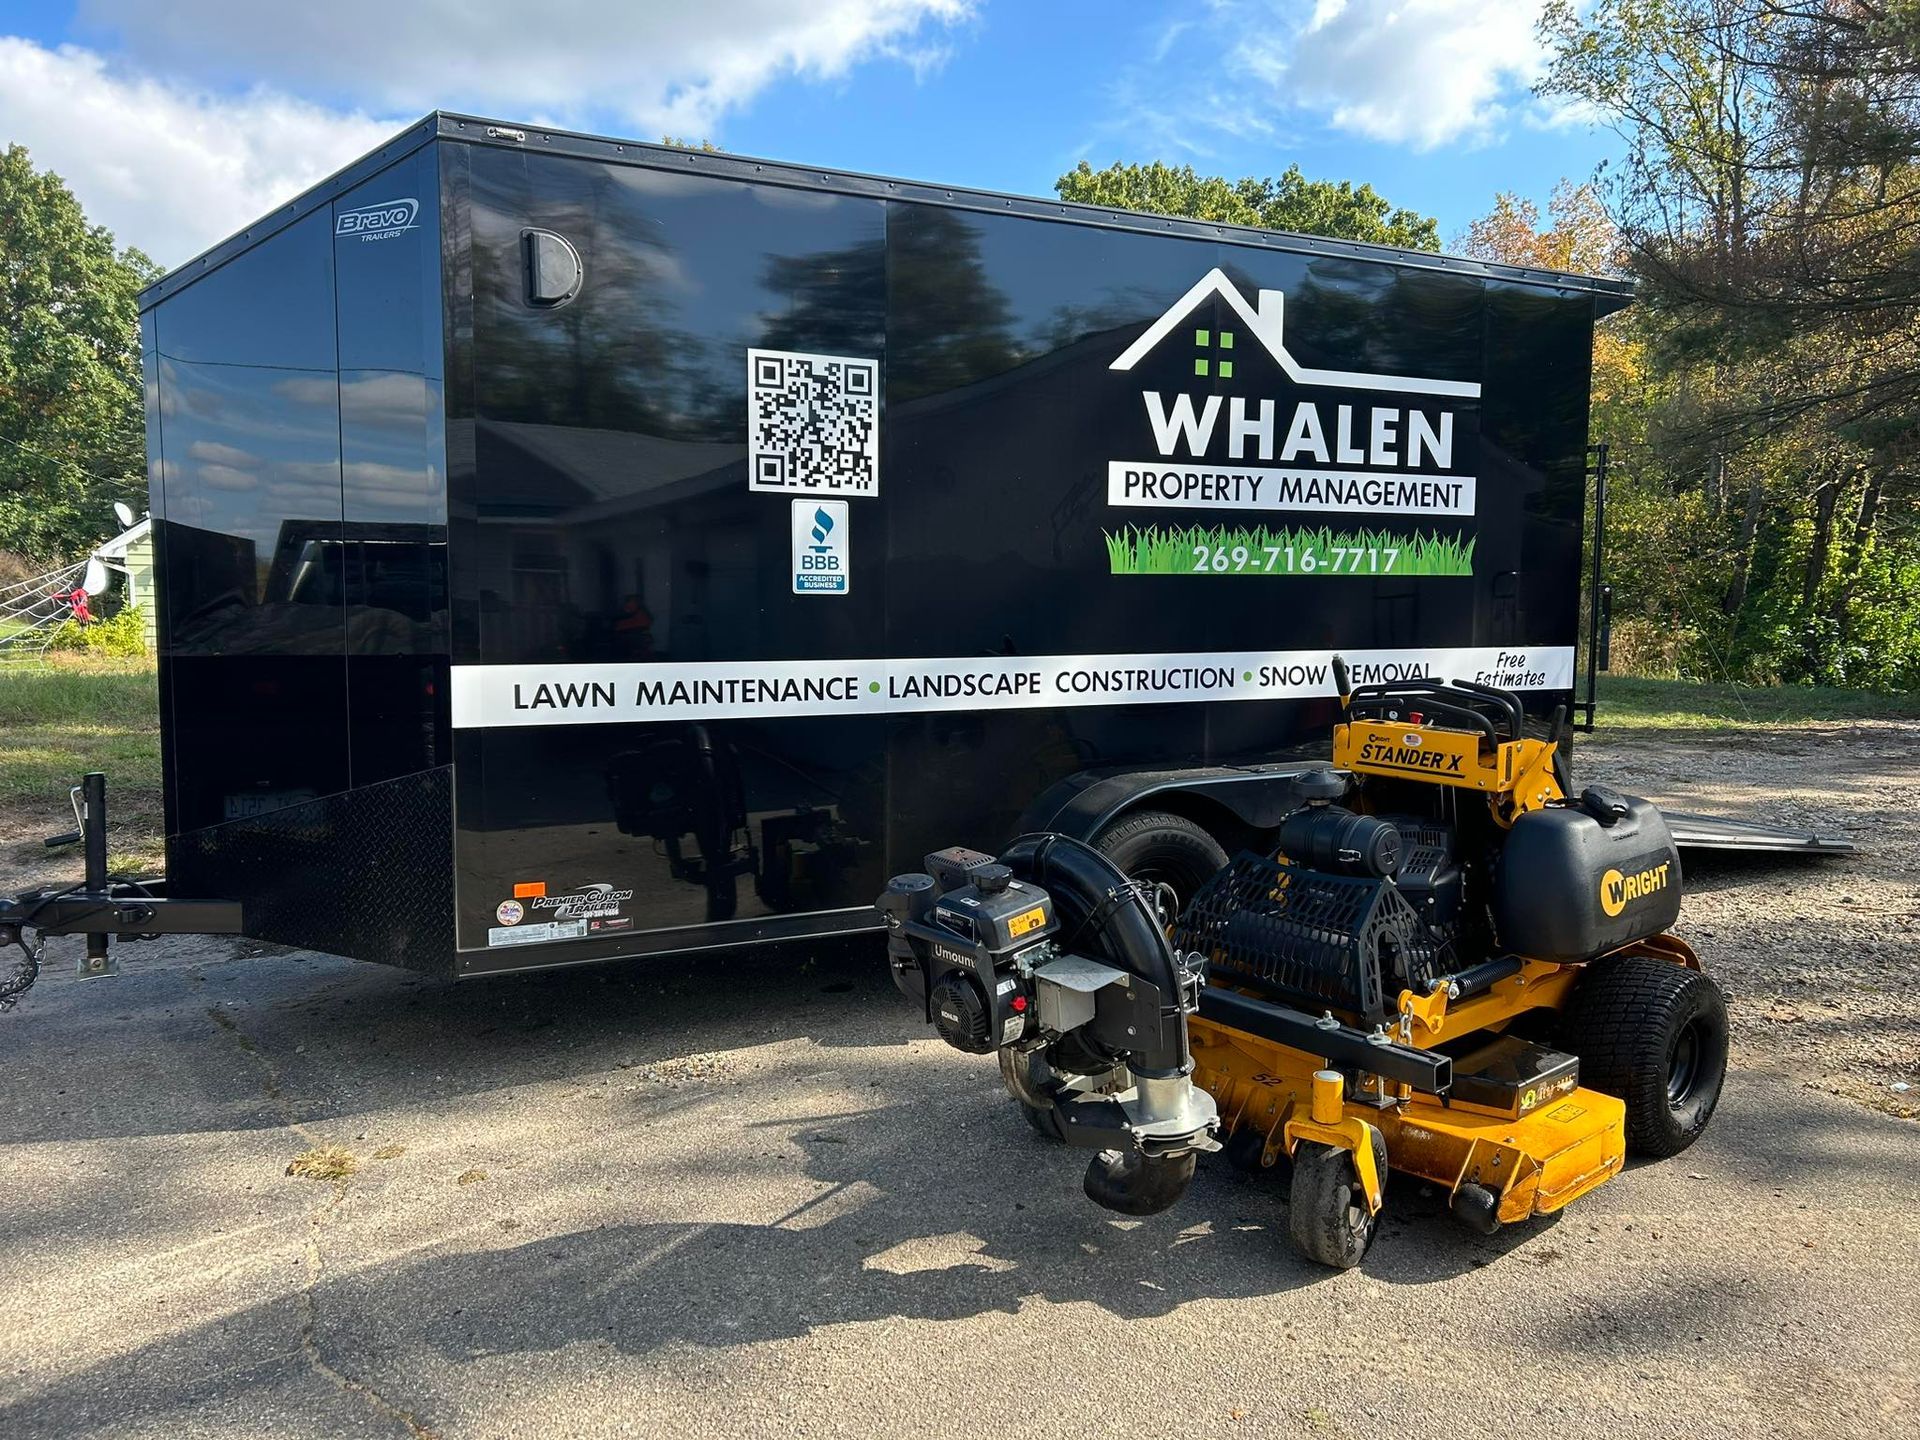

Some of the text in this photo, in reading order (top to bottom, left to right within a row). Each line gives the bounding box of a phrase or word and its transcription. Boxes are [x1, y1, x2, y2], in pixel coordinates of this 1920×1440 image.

[336, 208, 408, 234] Bravo
[361, 230, 401, 242] TRAILERS
[1142, 391, 1454, 468] WHALEN
[1124, 471, 1463, 508] PROPERTY MANAGEMENT
[802, 555, 840, 570] BBB
[1192, 546, 1400, 574] 269-716-7717
[1496, 651, 1526, 668] Free
[514, 663, 1430, 710] LAWN MAINTENANCE LANDSCAPE CONSTRUCTION SNOW EMOVAL
[1475, 669, 1546, 687] Estimates
[1360, 743, 1463, 771] STANDER X
[1605, 864, 1668, 907] WRIGHT
[532, 889, 633, 908] PREMIER CUSTOM
[566, 901, 619, 915] TRAILERS
[1251, 1073, 1283, 1087] 52
